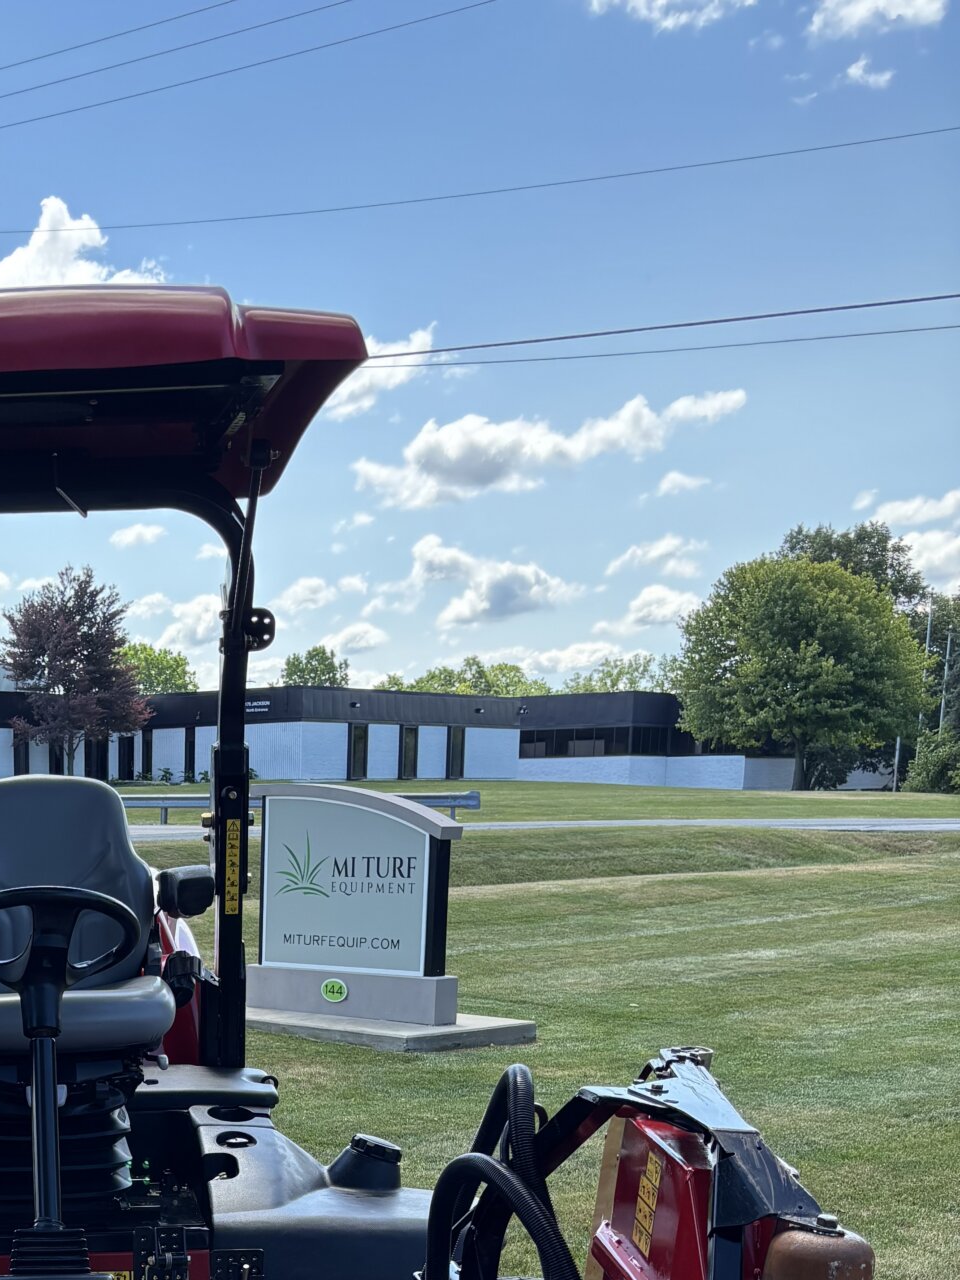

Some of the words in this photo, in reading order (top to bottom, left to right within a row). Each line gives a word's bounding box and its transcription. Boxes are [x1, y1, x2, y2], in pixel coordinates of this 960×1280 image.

[331, 856, 356, 878] MI
[362, 856, 417, 879] TURF
[331, 881, 416, 896] EQUIPMENT
[283, 933, 400, 950] MITURFEQUIP.COM
[324, 984, 344, 996] 144
